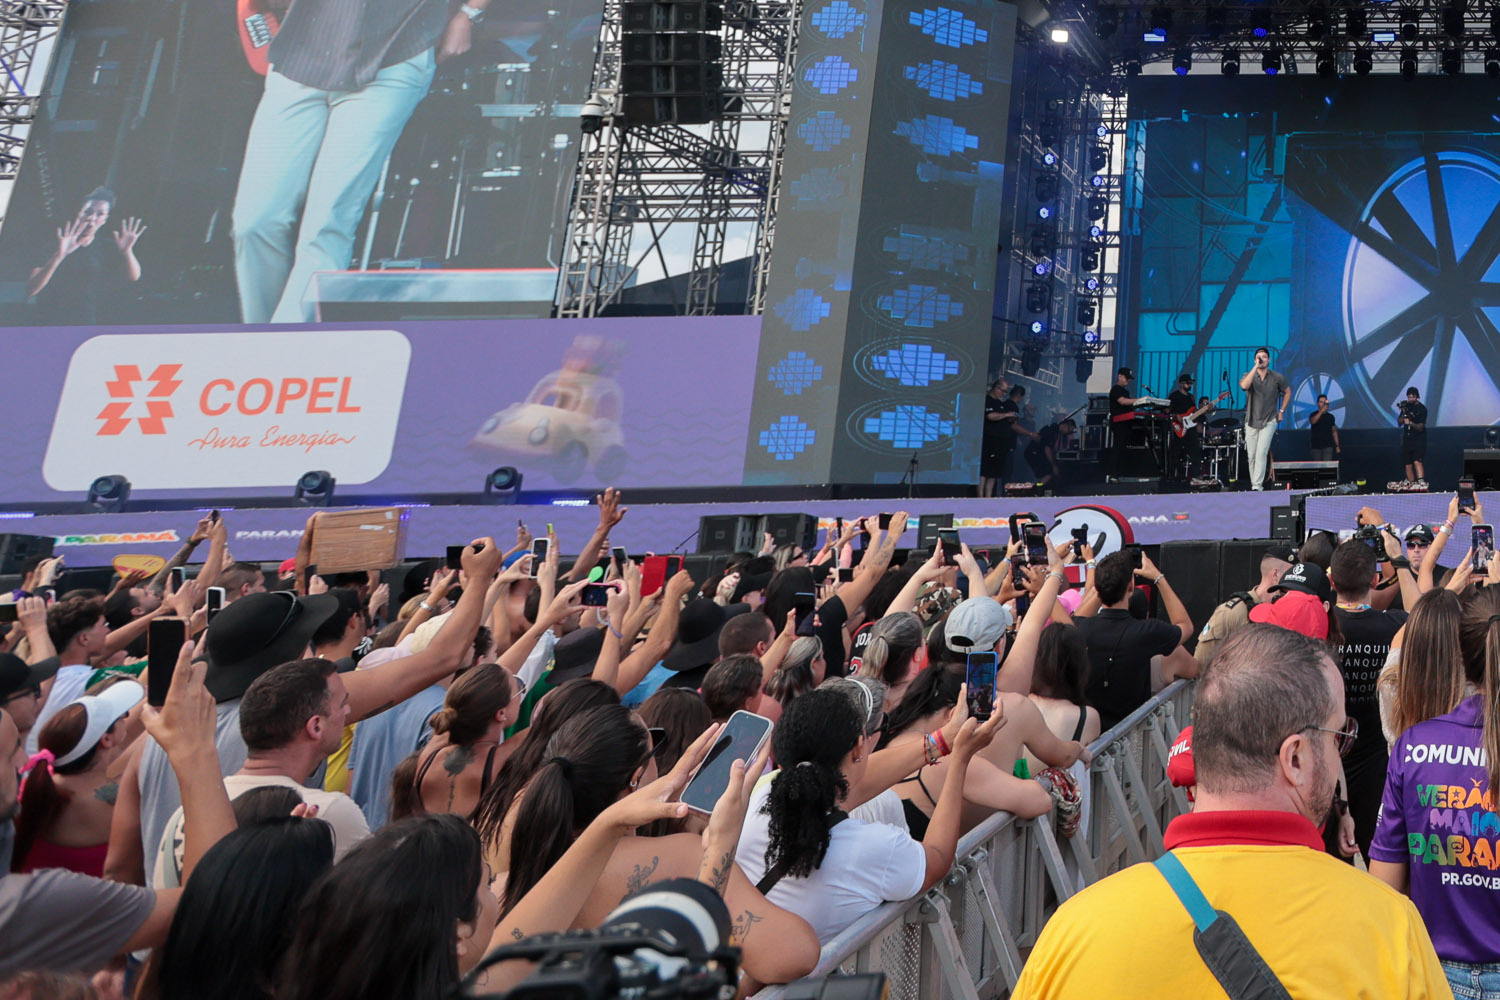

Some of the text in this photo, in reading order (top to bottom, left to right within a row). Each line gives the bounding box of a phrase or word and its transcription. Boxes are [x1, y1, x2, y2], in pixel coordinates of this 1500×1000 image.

[199, 376, 362, 416] COPEL
[187, 425, 356, 454] Pura Energia
[1338, 644, 1390, 654] RANQUI
[1341, 659, 1384, 667] ANQUI
